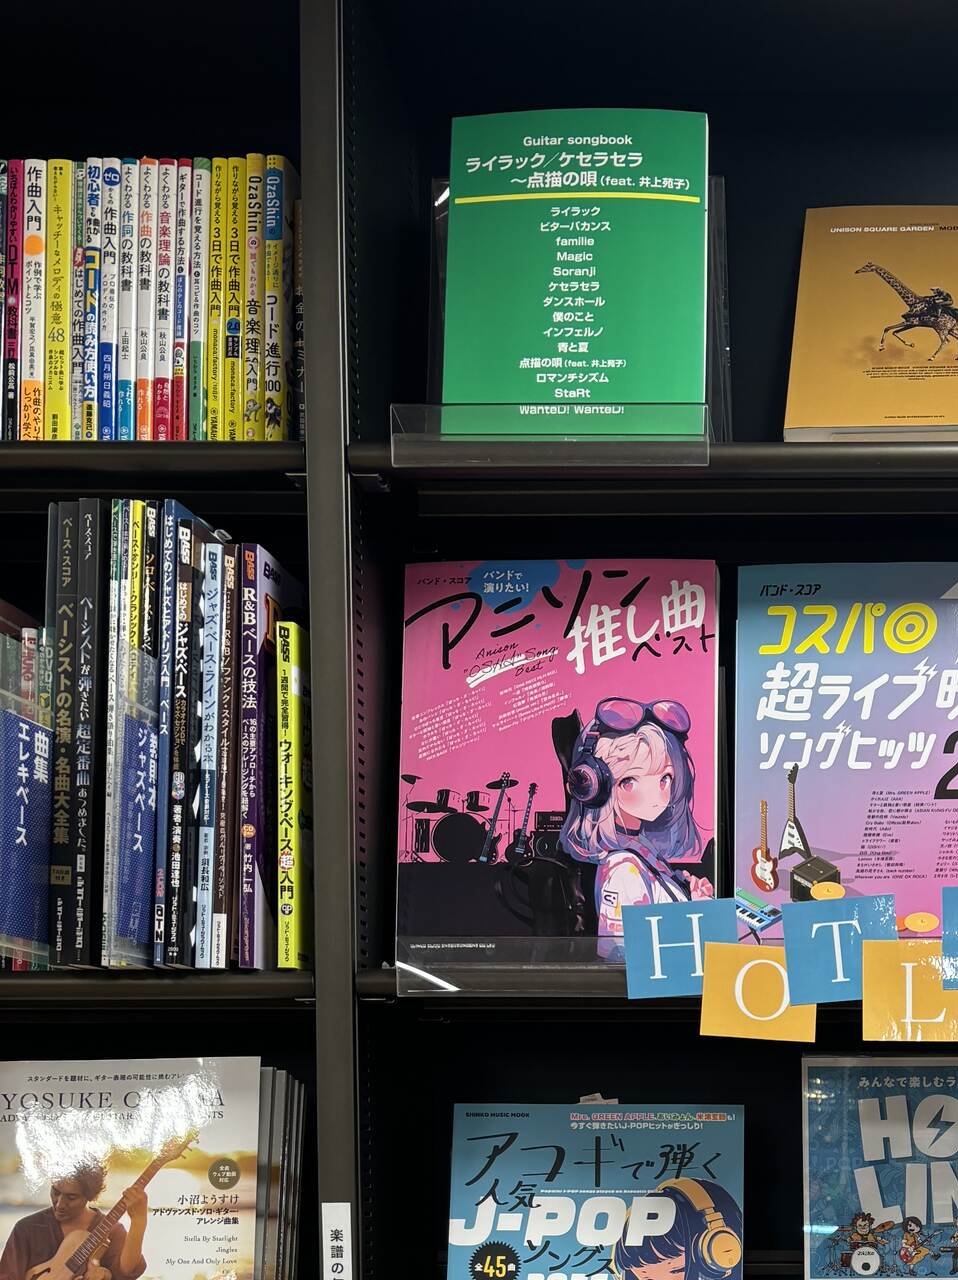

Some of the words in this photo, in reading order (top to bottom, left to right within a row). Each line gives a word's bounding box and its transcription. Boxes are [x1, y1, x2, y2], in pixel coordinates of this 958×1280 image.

[523, 135, 563, 147] Guitar
[567, 134, 633, 146] songbook
[26, 166, 42, 231] 作曲入門
[550, 207, 601, 217] ライラック
[540, 222, 611, 232] ビターバカンス
[555, 237, 594, 246] familie
[556, 251, 593, 263] Magic
[553, 266, 596, 277] Soranji
[549, 281, 600, 292] ケセラセラ
[543, 296, 605, 307] ダンスホール
[552, 312, 594, 322] 僕のこと
[543, 327, 604, 337] インフェルノ
[557, 342, 589, 353] 青と夏
[519, 358, 562, 368] 点描の唄
[536, 373, 609, 384] ロマンチシズム
[555, 389, 591, 398] StaRt
[483, 570, 523, 580] バンドで
[417, 577, 472, 585] バンド・スコア
[760, 584, 821, 596] バンド・スコア
[405, 570, 650, 670] アニソン
[567, 580, 707, 675] 推し曲
[632, 624, 716, 662] ベスト
[759, 721, 937, 770] ソングヒッツ
[15, 723, 31, 847] エレキベース
[465, 1132, 722, 1188] アコギで弾く
[177, 1194, 239, 1205] 小沼ようすけ
[475, 1179, 542, 1212] 人気
[196, 1217, 239, 1225] アレンジ曲集
[449, 1196, 677, 1247] J-POP
[213, 1235, 238, 1243] Starlight
[523, 1240, 615, 1276] ソングス
